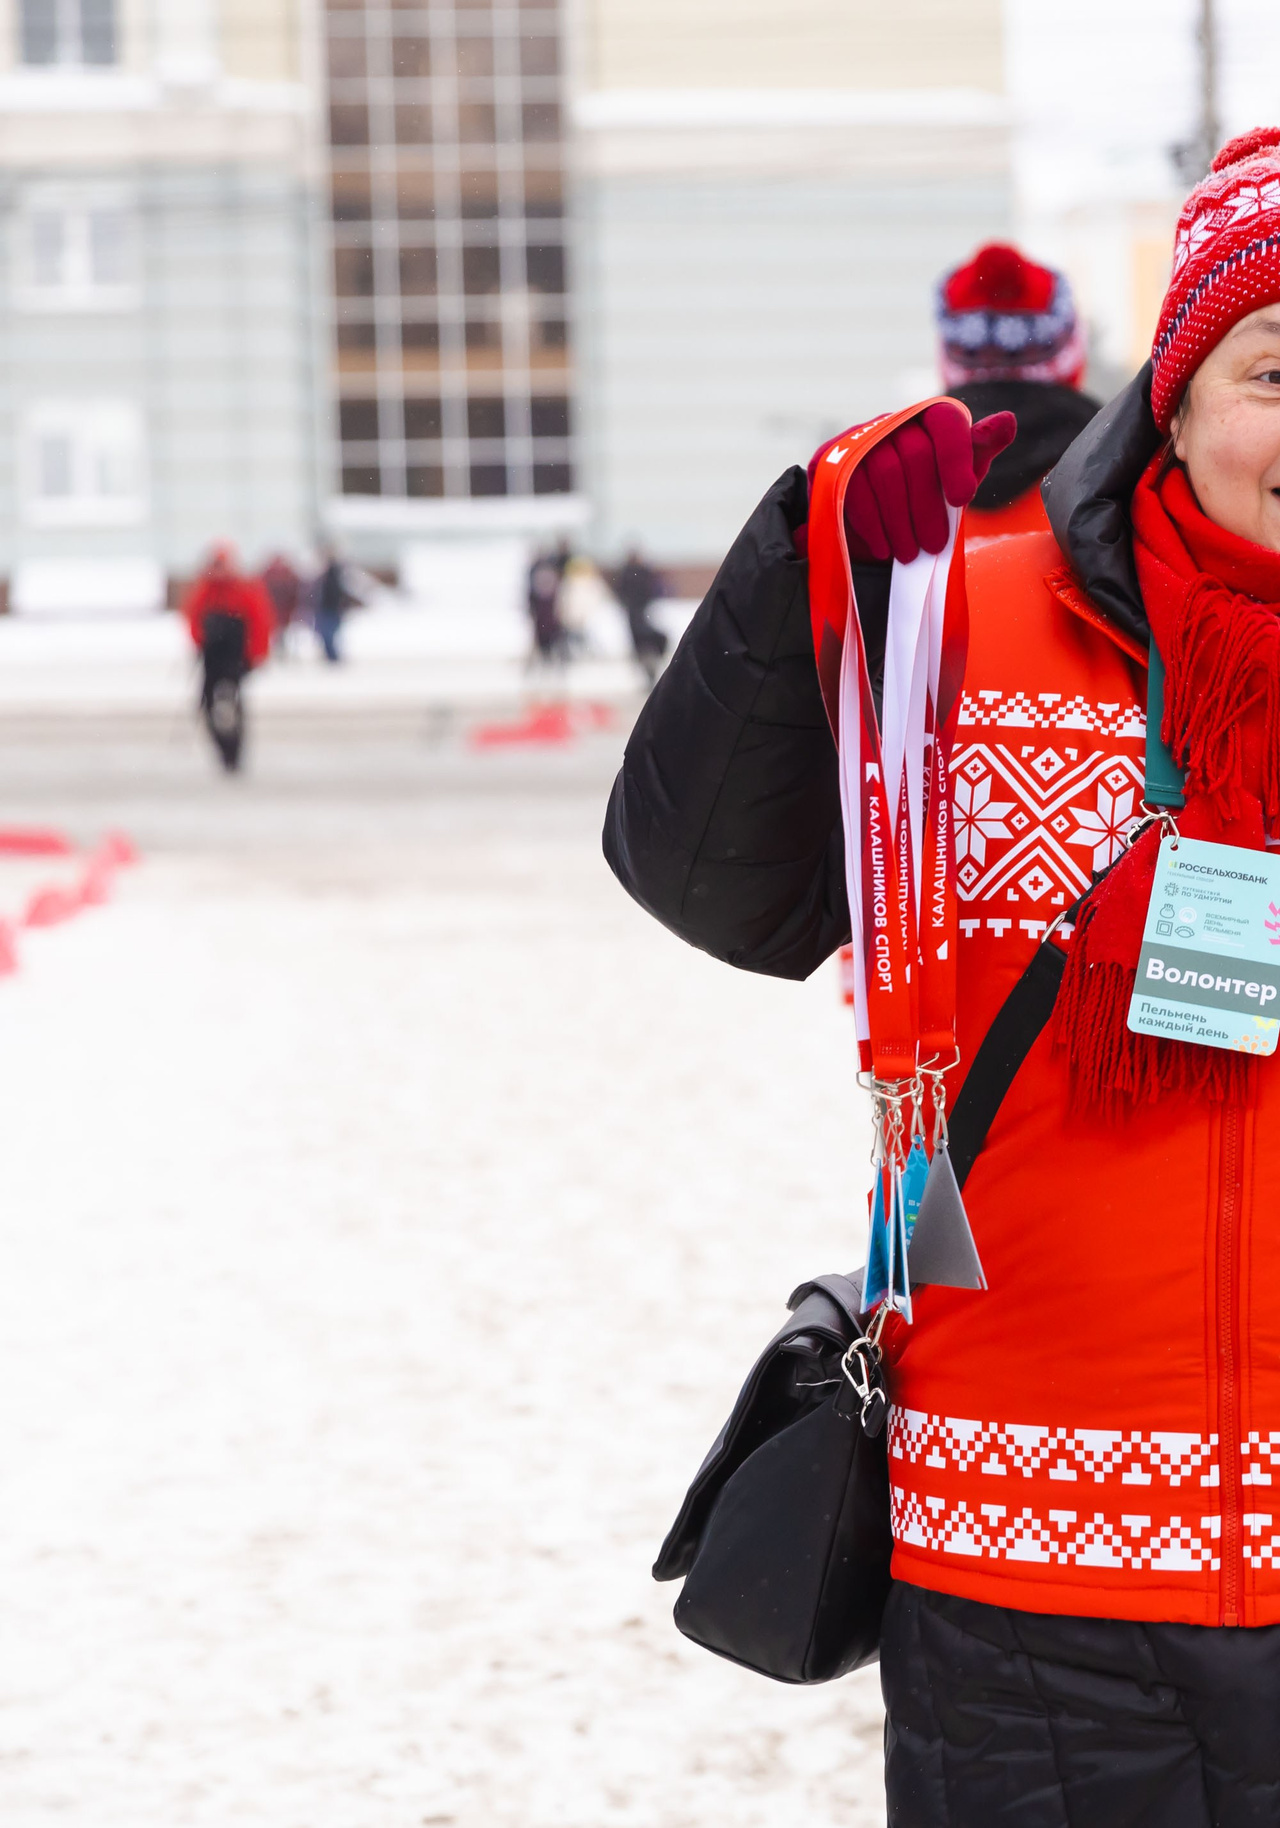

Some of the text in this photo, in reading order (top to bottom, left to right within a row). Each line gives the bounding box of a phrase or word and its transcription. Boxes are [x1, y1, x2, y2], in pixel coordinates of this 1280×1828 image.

[932, 799, 948, 928] КАЛАШНИКОВ
[1178, 862, 1269, 885] РОССЕЛЬХОЗБАНК
[869, 796, 893, 993] КАЛАШНИКОВ СПОРТ
[1181, 890, 1233, 905] ПО УДМУРТИИ
[1145, 957, 1278, 1006] Волонтер
[1140, 1002, 1207, 1024] Пельмень
[1138, 1016, 1229, 1040] каждый день
